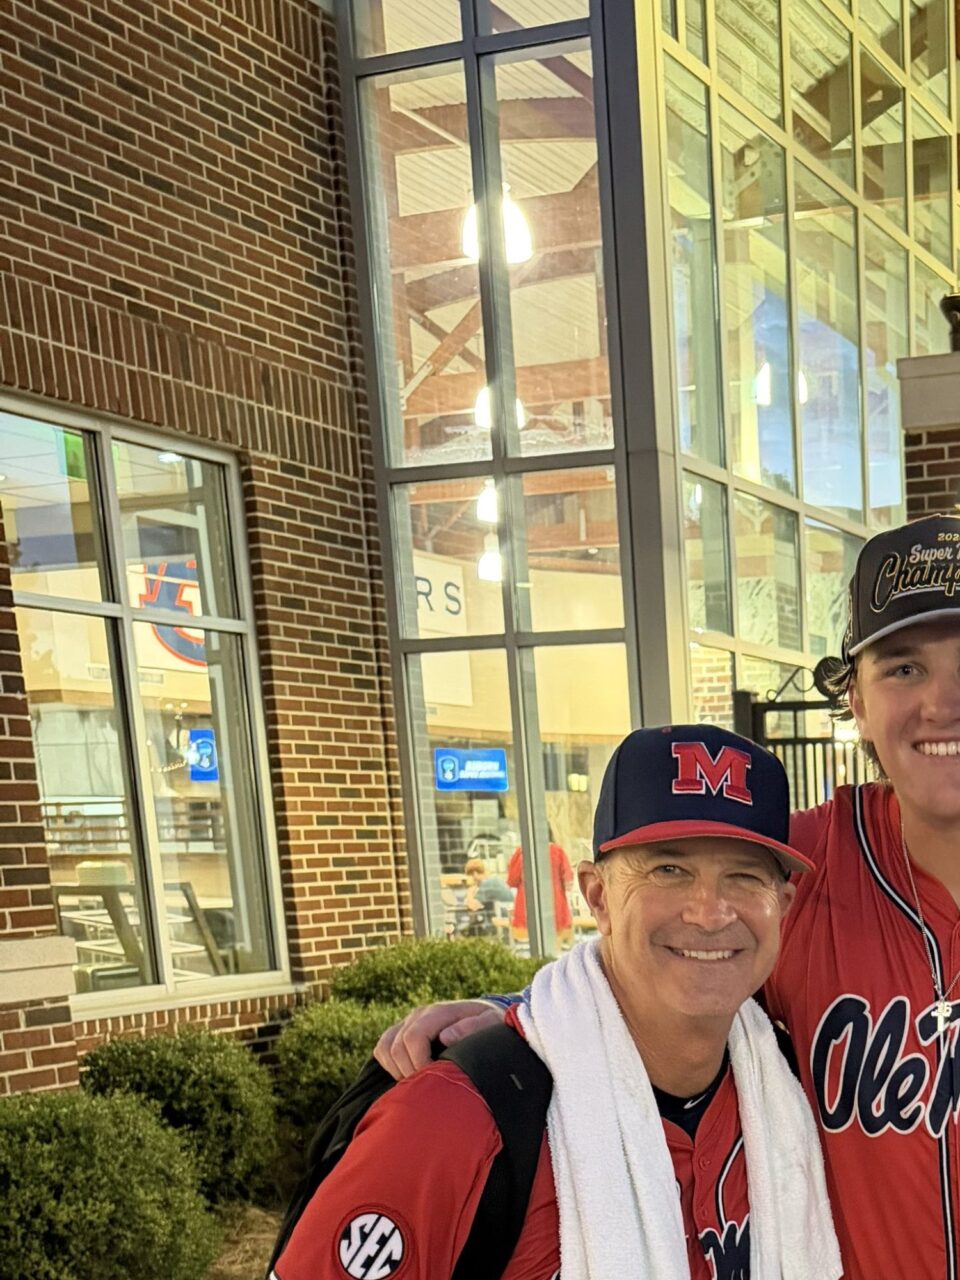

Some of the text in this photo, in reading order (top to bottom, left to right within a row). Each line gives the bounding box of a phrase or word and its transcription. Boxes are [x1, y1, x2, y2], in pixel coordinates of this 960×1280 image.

[909, 543, 954, 565] Super
[671, 741, 753, 806] M
[810, 993, 930, 1139] Ole
[339, 1212, 403, 1280] SEC
